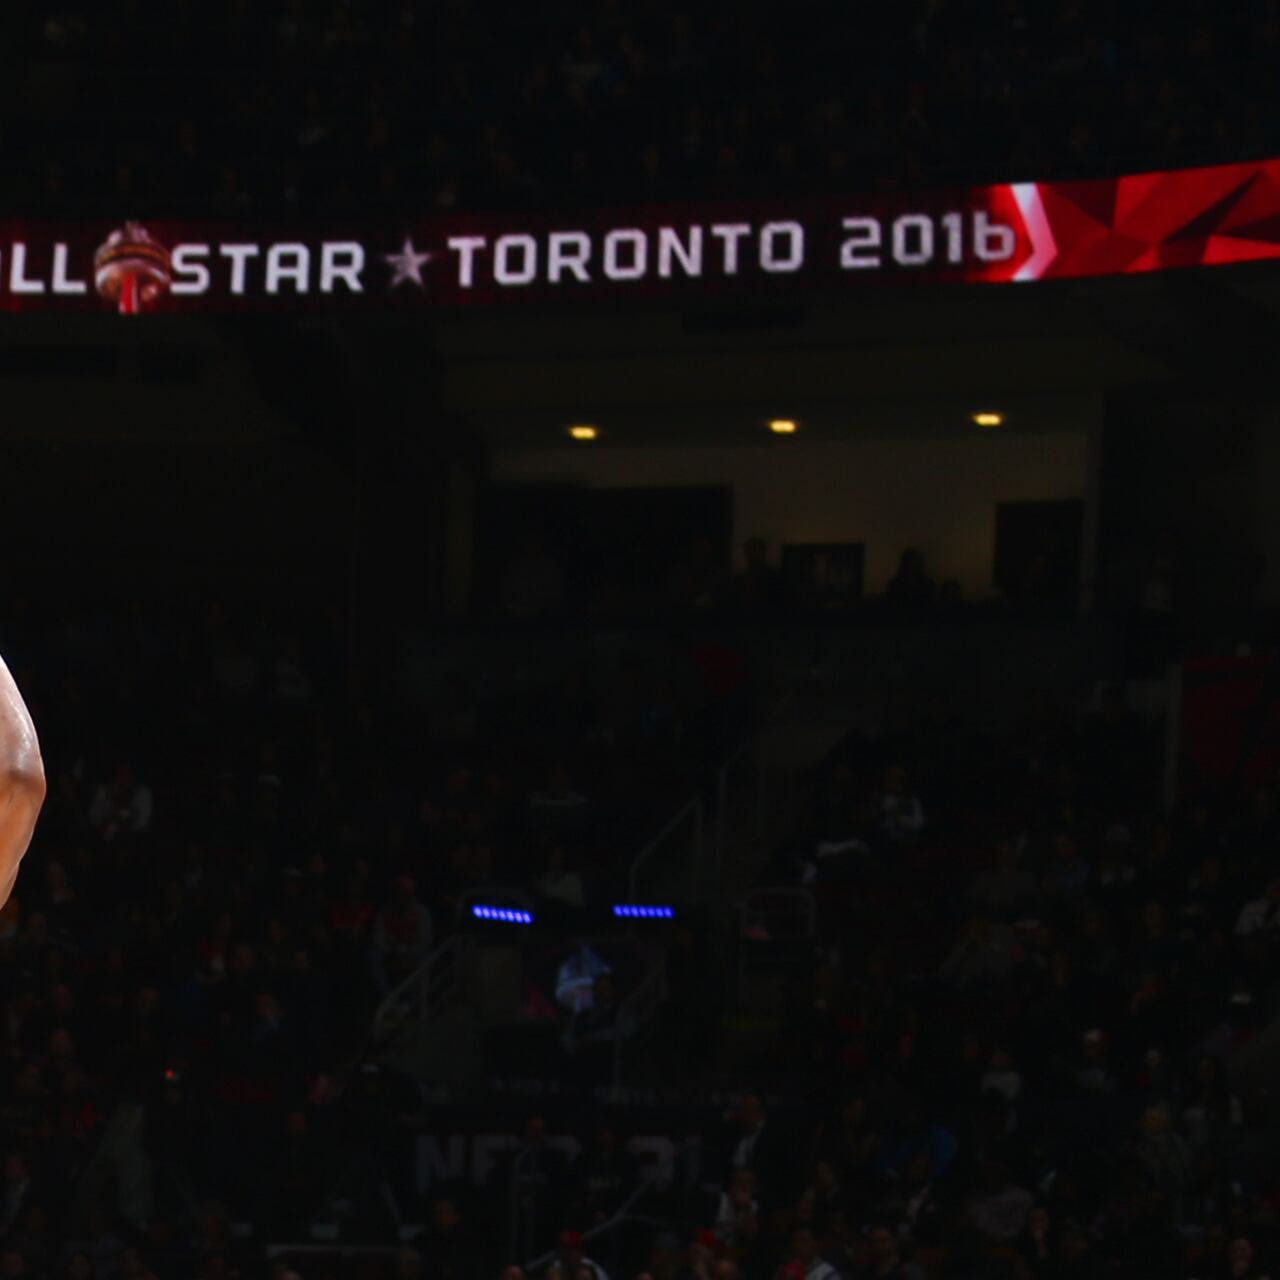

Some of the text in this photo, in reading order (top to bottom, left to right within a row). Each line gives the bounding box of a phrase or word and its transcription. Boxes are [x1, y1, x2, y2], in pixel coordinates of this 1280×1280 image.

[169, 243, 365, 294] STAR
[447, 221, 805, 287] TORONTO
[840, 213, 1015, 268] 2016
